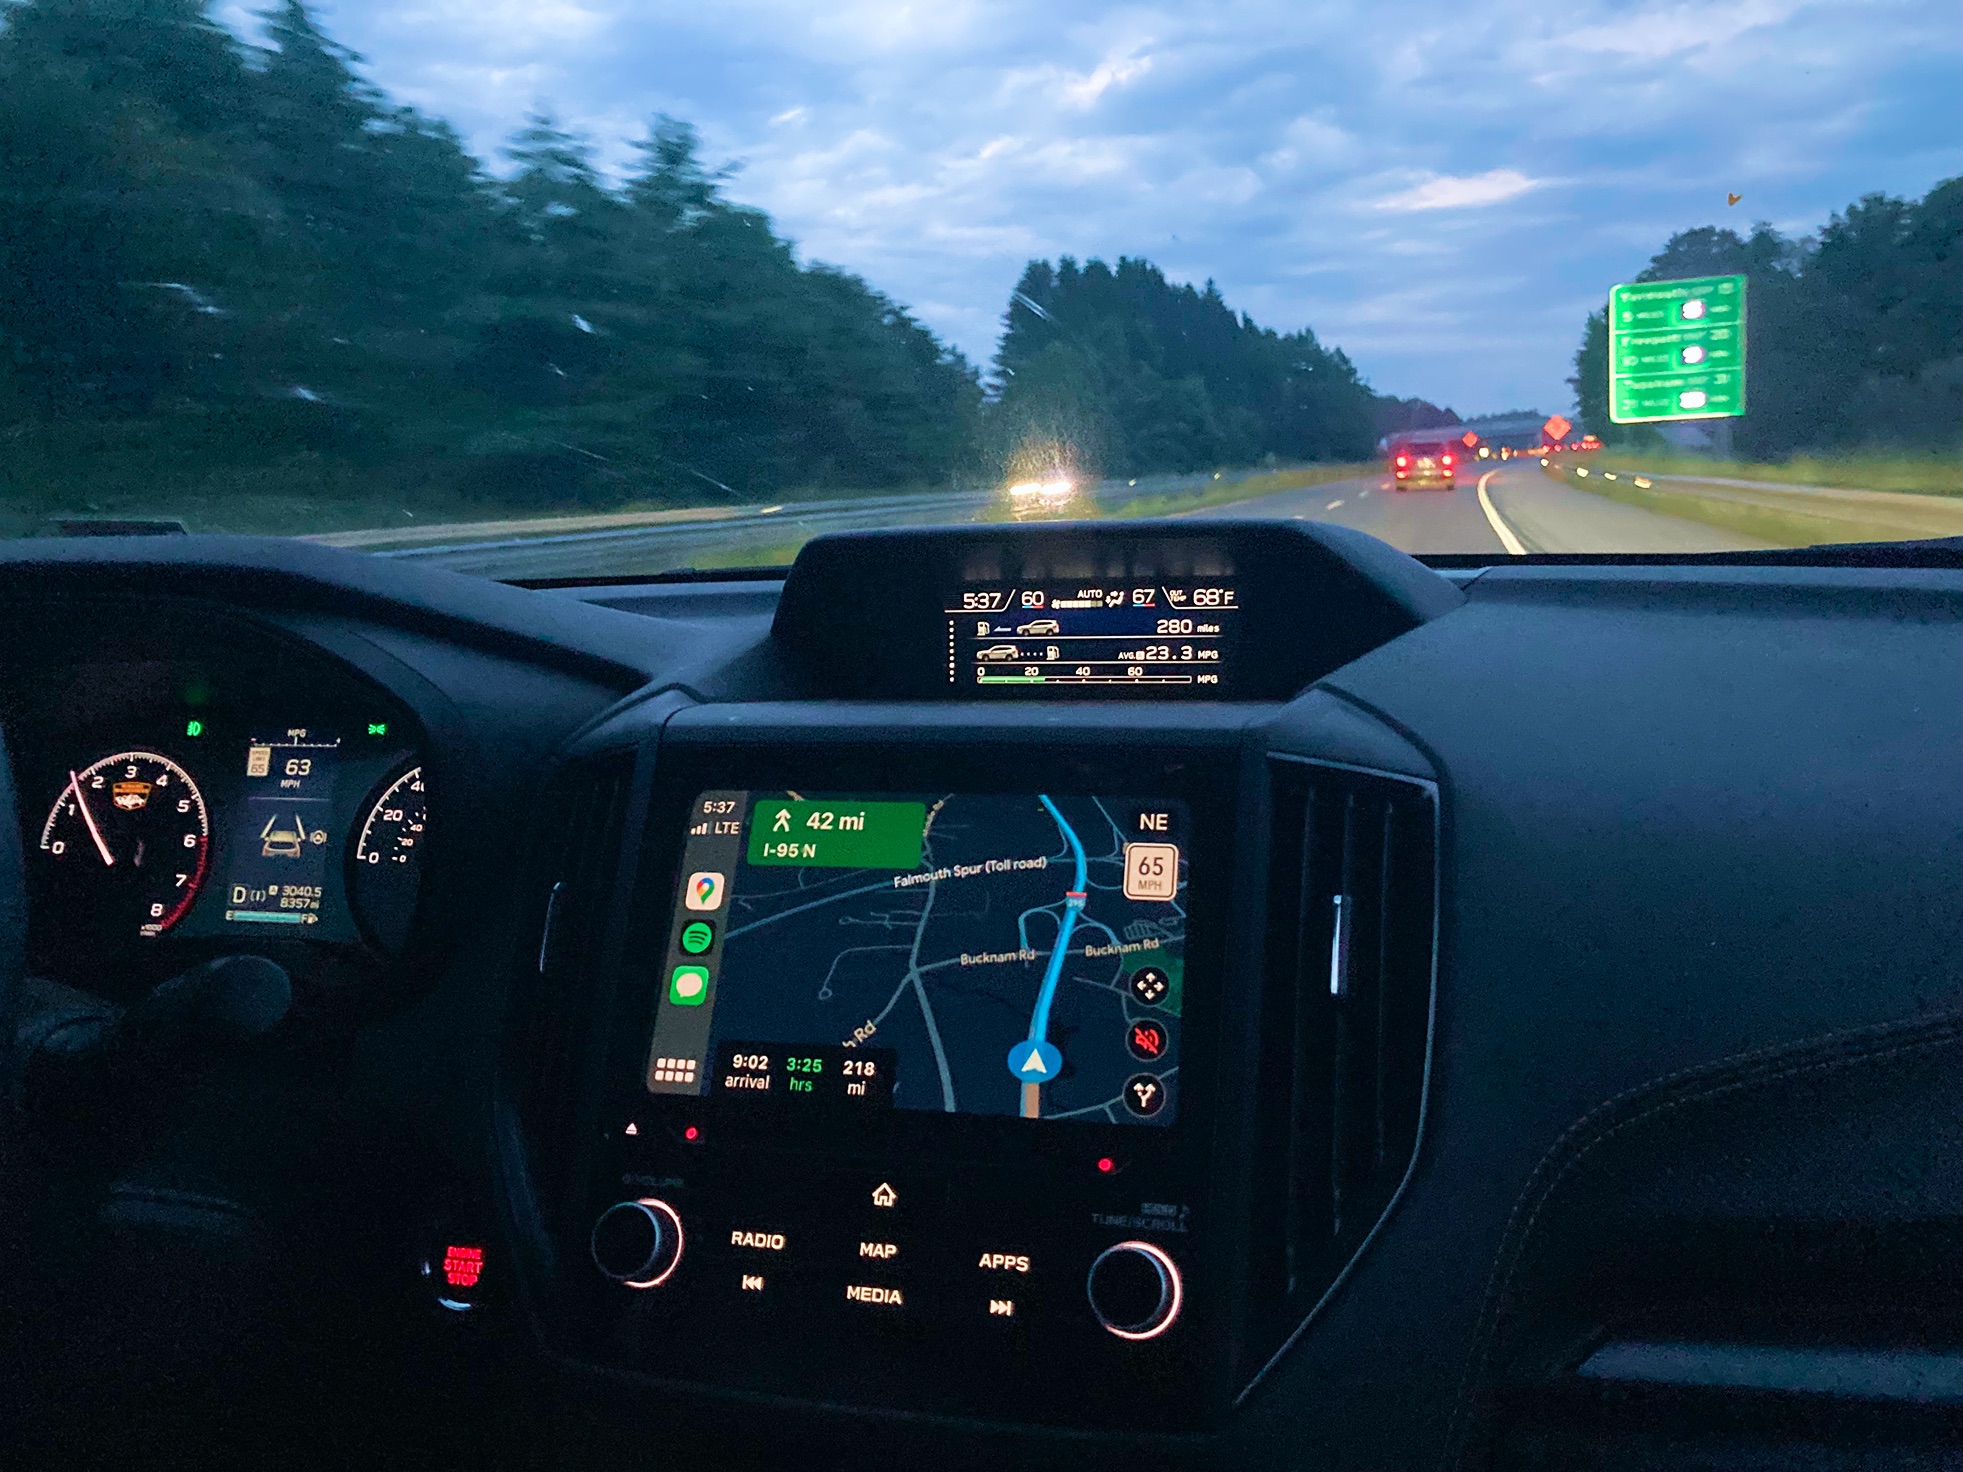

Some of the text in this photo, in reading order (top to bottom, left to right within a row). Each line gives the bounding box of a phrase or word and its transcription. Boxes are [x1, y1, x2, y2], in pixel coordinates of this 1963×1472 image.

[963, 592, 1002, 609] 5:37
[1021, 591, 1044, 606] 60
[1077, 589, 1103, 599] AUTO
[1132, 589, 1155, 603] 67
[1156, 619, 1220, 634] 280 miles
[1197, 650, 1219, 660] MPG
[977, 666, 1143, 676] 0 20 40 60
[1197, 675, 1218, 684] MPG
[125, 765, 138, 778] 3
[250, 763, 265, 774] 65
[285, 758, 312, 776] 63
[91, 776, 104, 789] 2
[155, 774, 168, 787] 4
[280, 779, 301, 788] MPH
[67, 803, 76, 816] 1
[176, 799, 190, 813] 5
[703, 801, 735, 814] 5:37
[383, 809, 403, 821] 20
[806, 811, 866, 831] 42 mi
[1139, 813, 1169, 831] NE
[410, 824, 423, 832] 40
[715, 822, 740, 835] LTE
[52, 841, 65, 854] 0
[183, 834, 197, 848] 6
[401, 838, 414, 847] 20
[368, 851, 380, 864] 0
[763, 843, 817, 858] I-95 N
[399, 854, 407, 863] 0
[893, 856, 1047, 888] Falmouth Spur (Toll road)
[1138, 856, 1164, 876] 65
[175, 873, 187, 887] 7
[1138, 880, 1162, 891] MPH
[232, 886, 247, 904] D
[282, 885, 322, 898] 3040.5
[150, 903, 164, 917] 8
[1085, 938, 1160, 957] Bucknam Rd
[960, 949, 1036, 966] Bucknam Rd
[853, 1019, 877, 1043] Rd
[732, 1054, 876, 1076] 9:02 3:25 218
[724, 1074, 867, 1096] arrival hrs mi
[731, 1230, 786, 1250] RADIO
[859, 1242, 898, 1259] MAP
[443, 1258, 484, 1274] START
[979, 1253, 1031, 1272] APPS
[447, 1272, 479, 1287] STOP
[846, 1285, 903, 1305] MEDIA
